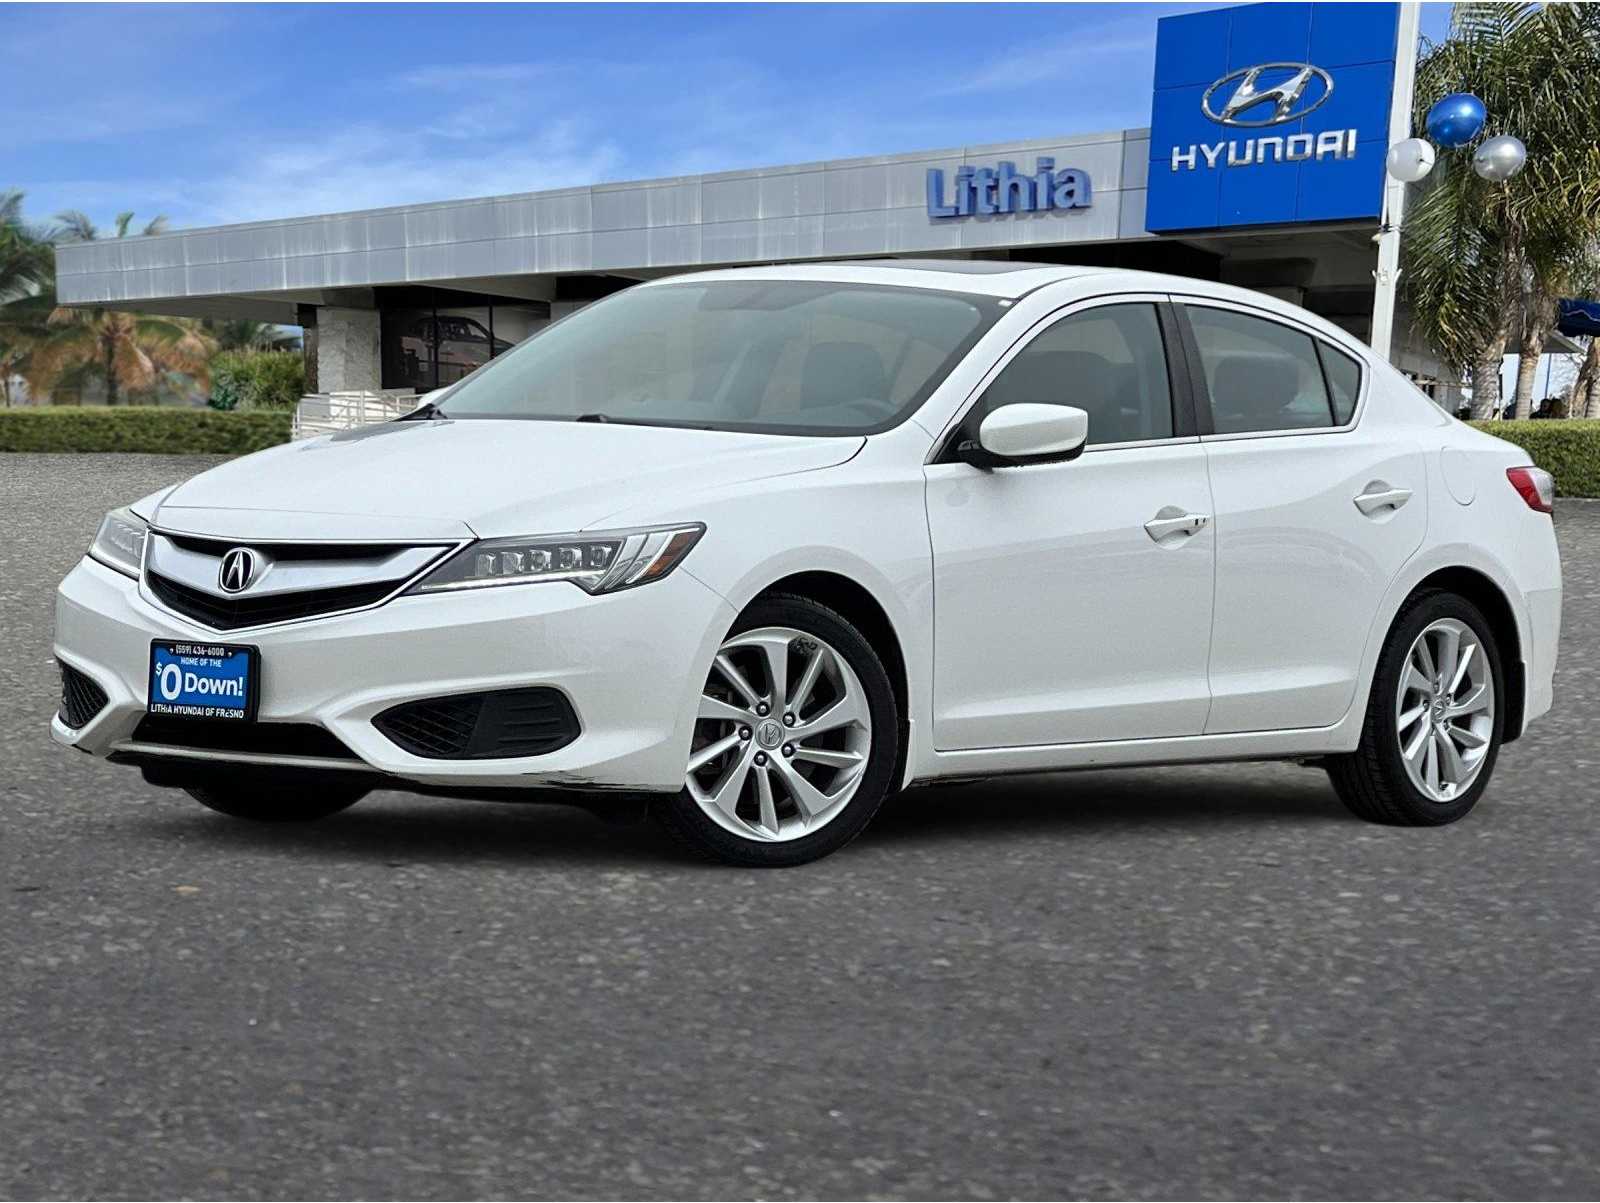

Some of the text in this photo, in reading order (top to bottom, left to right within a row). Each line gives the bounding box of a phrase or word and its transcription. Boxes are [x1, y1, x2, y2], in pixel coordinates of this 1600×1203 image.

[1171, 129, 1357, 172] HYUNDAI
[927, 157, 1092, 218] Lithia
[175, 644, 224, 656] (559) 436-6000
[180, 657, 222, 668] HOME OF THE
[155, 662, 243, 700] $0 Down!
[174, 706, 204, 716] HYUNDAI
[205, 707, 215, 717] OF
